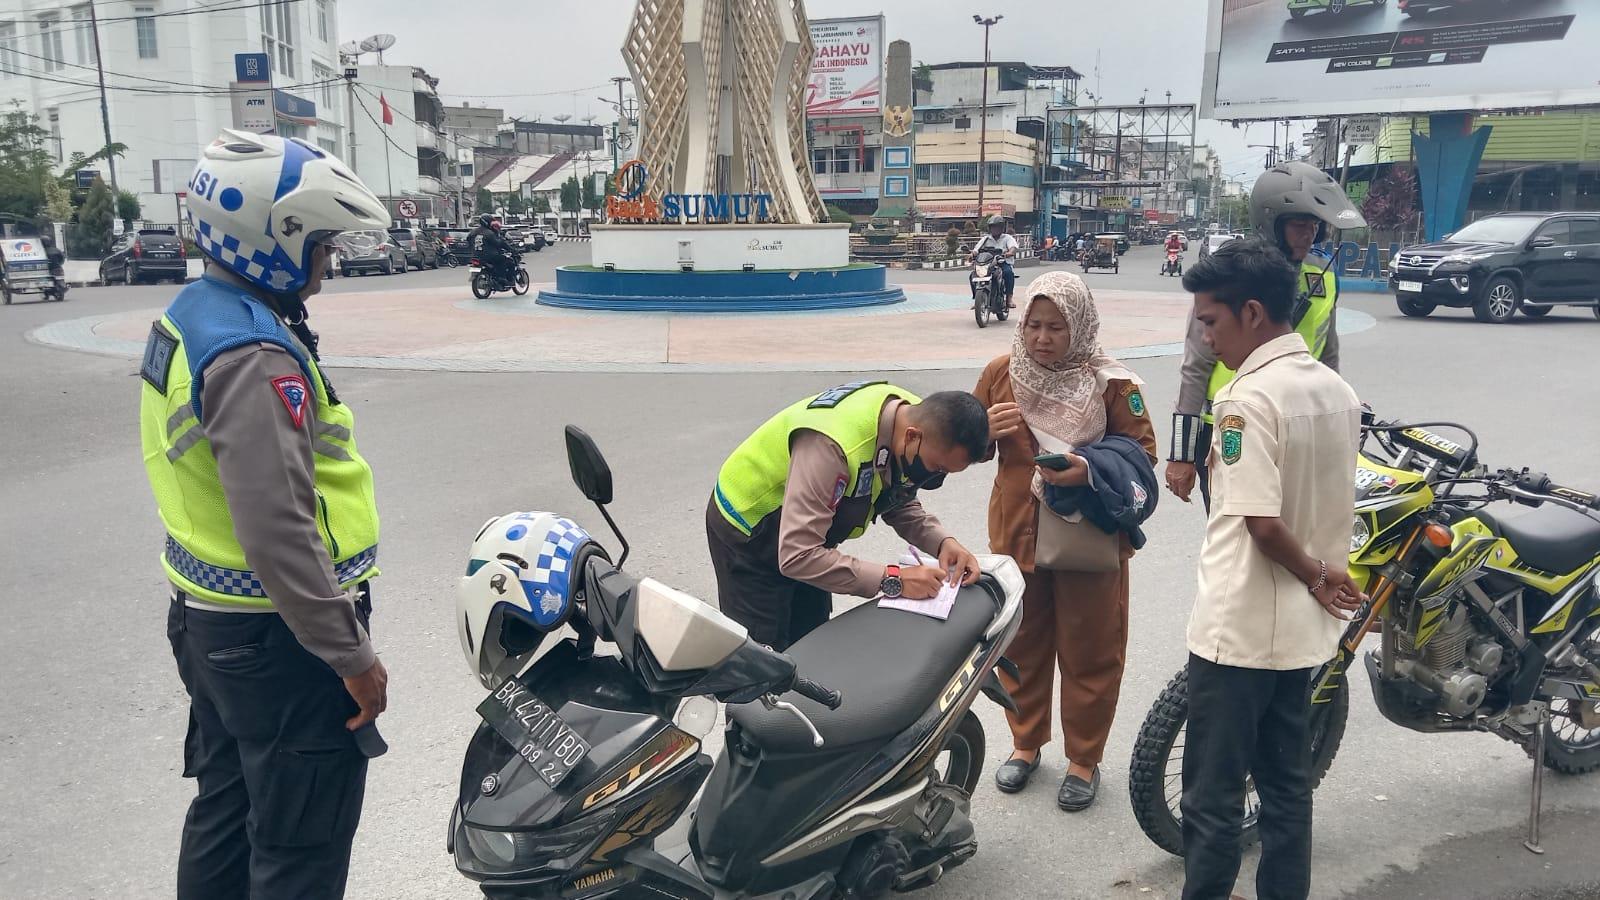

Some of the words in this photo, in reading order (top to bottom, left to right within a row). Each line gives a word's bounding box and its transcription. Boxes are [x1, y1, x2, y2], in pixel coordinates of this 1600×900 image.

[827, 59, 868, 67] INDONESIA
[1275, 47, 1306, 55] SATYA
[663, 192, 773, 219] SUMUT
[939, 645, 981, 713] GT
[495, 680, 526, 711] BK
[515, 699, 558, 739] 4211
[545, 725, 586, 767] YBD
[520, 743, 543, 763] 09
[541, 762, 562, 784] 24
[582, 752, 656, 810] GT
[573, 867, 615, 891] YAMAHA
